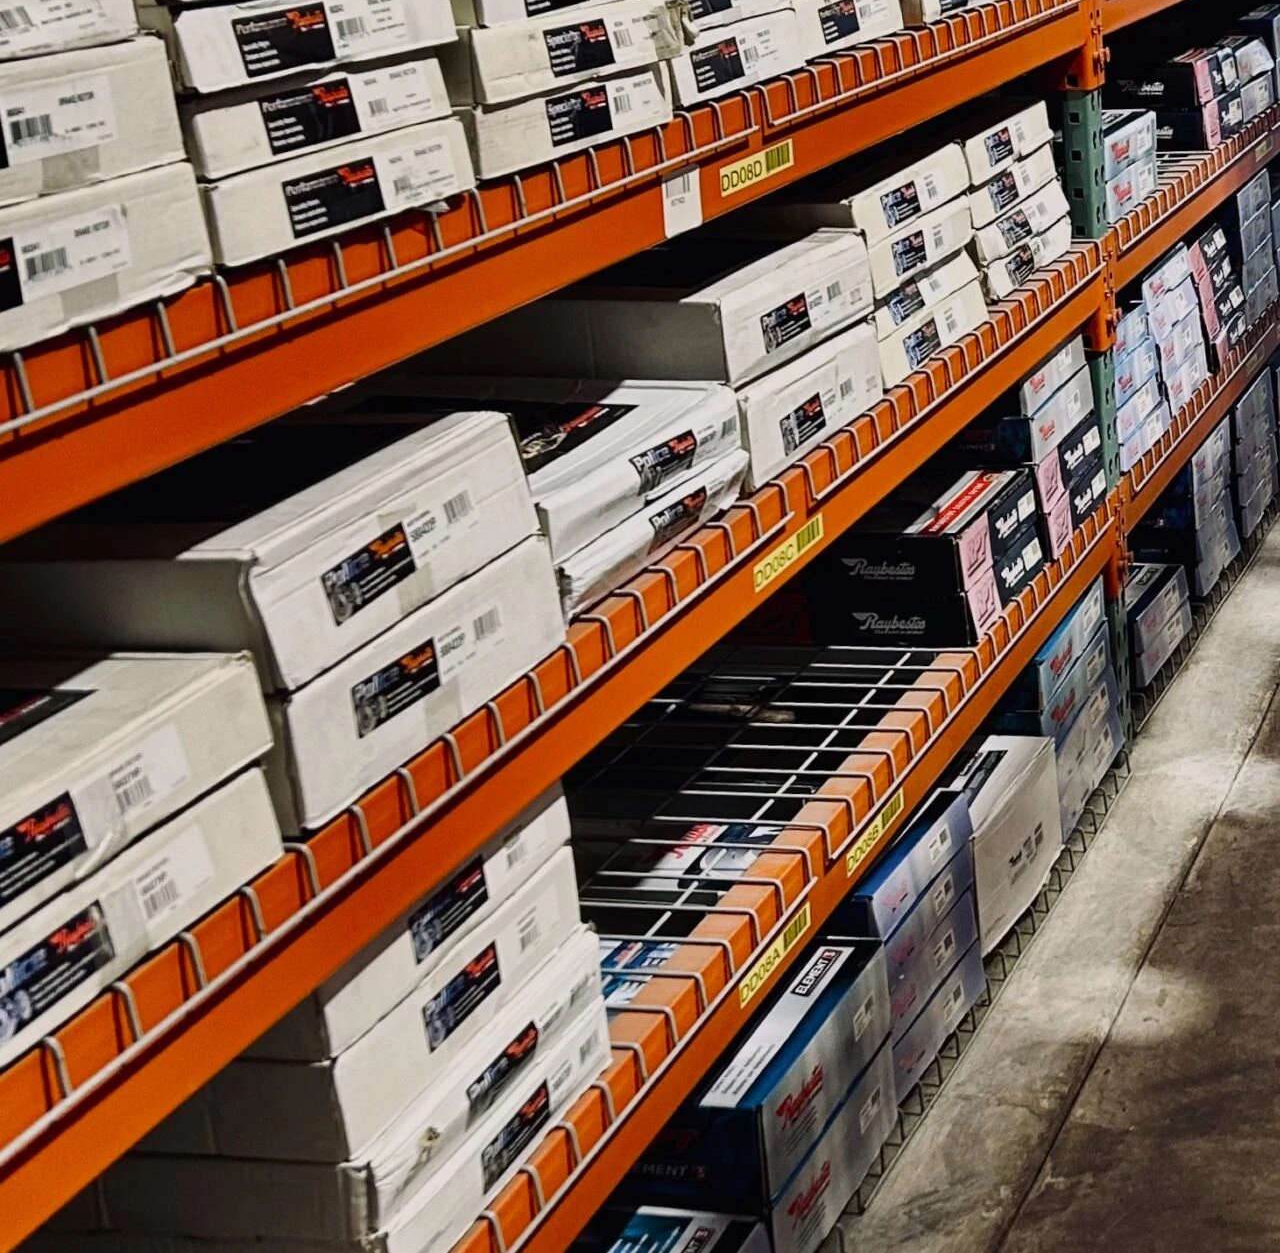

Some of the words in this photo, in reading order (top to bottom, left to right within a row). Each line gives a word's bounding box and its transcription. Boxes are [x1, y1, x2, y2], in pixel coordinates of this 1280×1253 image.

[547, 30, 581, 49] Specialty
[59, 95, 77, 106] BRAKE
[77, 91, 95, 101] ROTOR
[547, 98, 582, 117] Specialty
[721, 160, 762, 192] DD08D
[632, 445, 671, 471] Police
[651, 503, 684, 530] Police
[325, 552, 371, 586] Police
[755, 543, 794, 588] DD08C
[841, 558, 915, 578] Raybestos
[852, 612, 926, 632] Raybestos
[354, 666, 400, 698] Police
[846, 824, 880, 873] DD08B
[740, 947, 781, 1004] DD08A
[795, 957, 828, 996] ELEMENT
[824, 948, 837, 963] 3
[468, 1056, 509, 1100] Police
